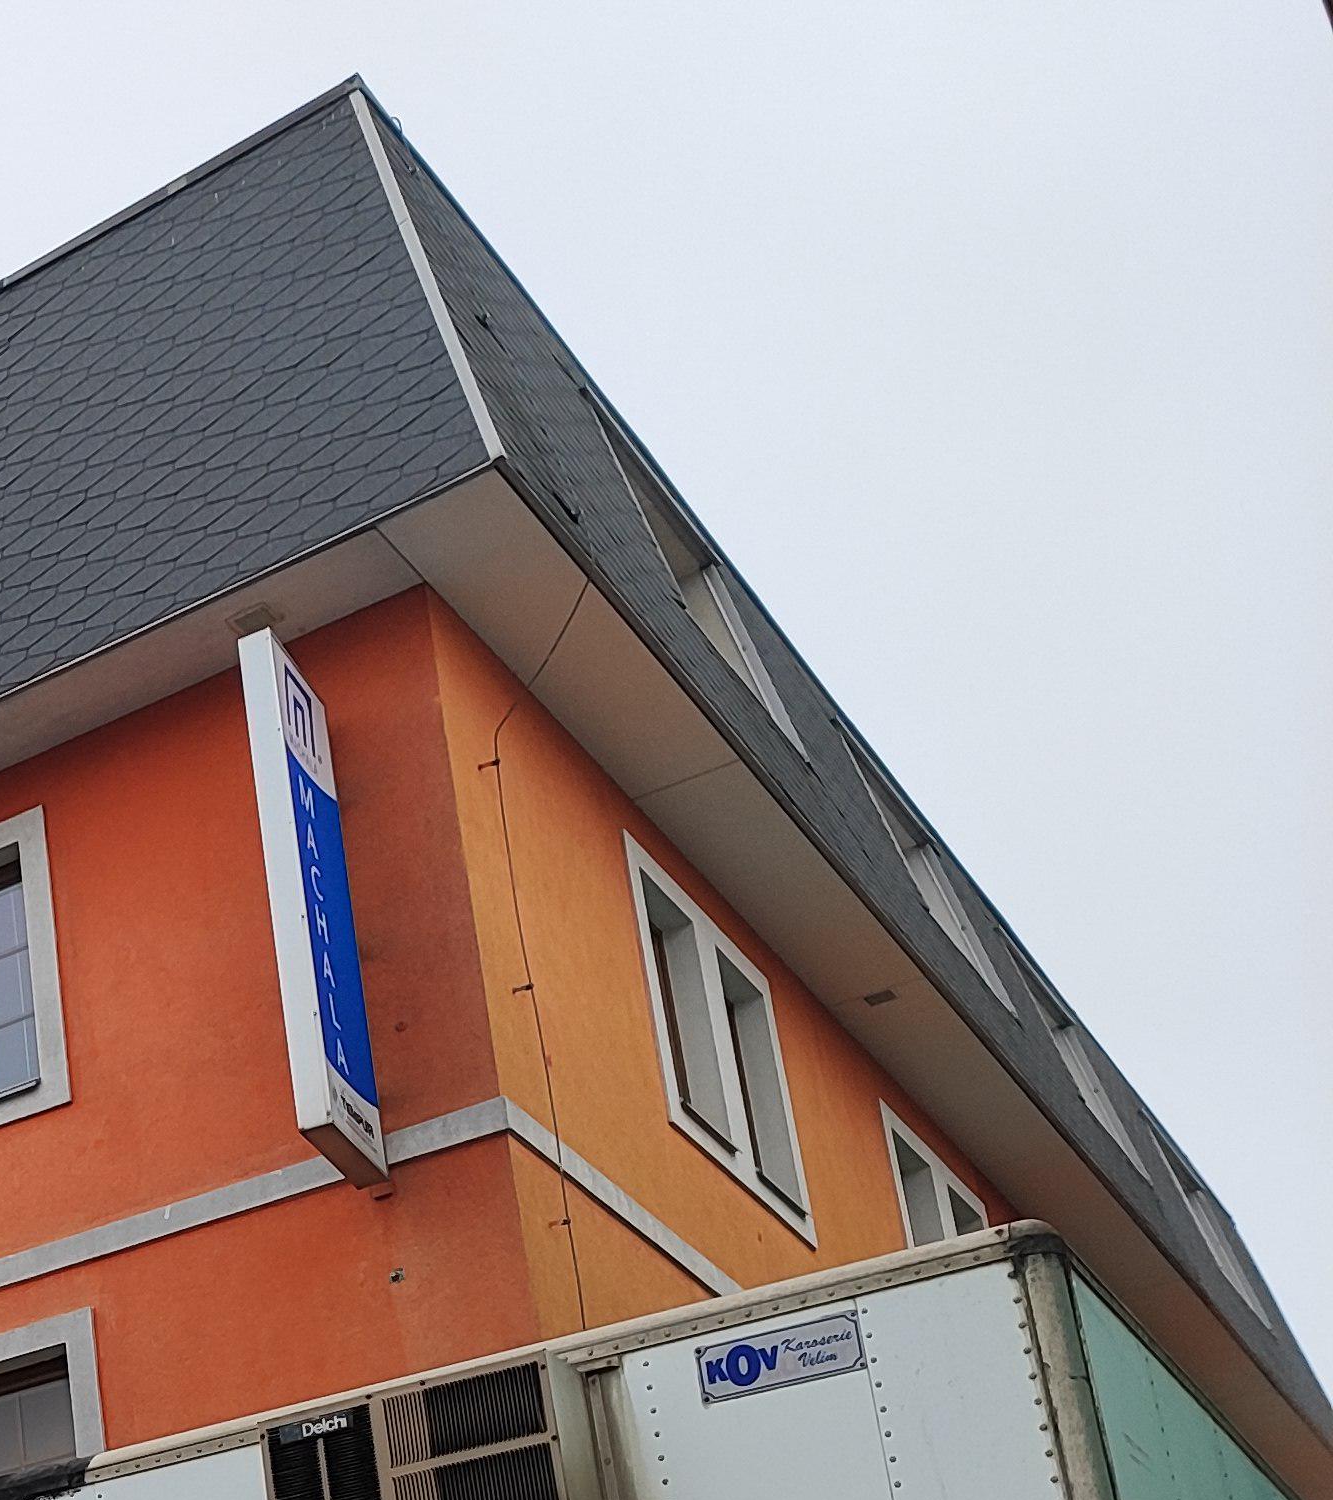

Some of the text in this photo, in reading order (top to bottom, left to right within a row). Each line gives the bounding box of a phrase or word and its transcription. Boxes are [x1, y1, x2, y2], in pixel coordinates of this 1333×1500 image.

[299, 774, 350, 1076] MACHALA
[781, 1329, 853, 1354] Karoserie
[705, 1344, 778, 1386] KOV
[798, 1350, 838, 1367] Velim
[301, 1414, 348, 1437] Delchi
